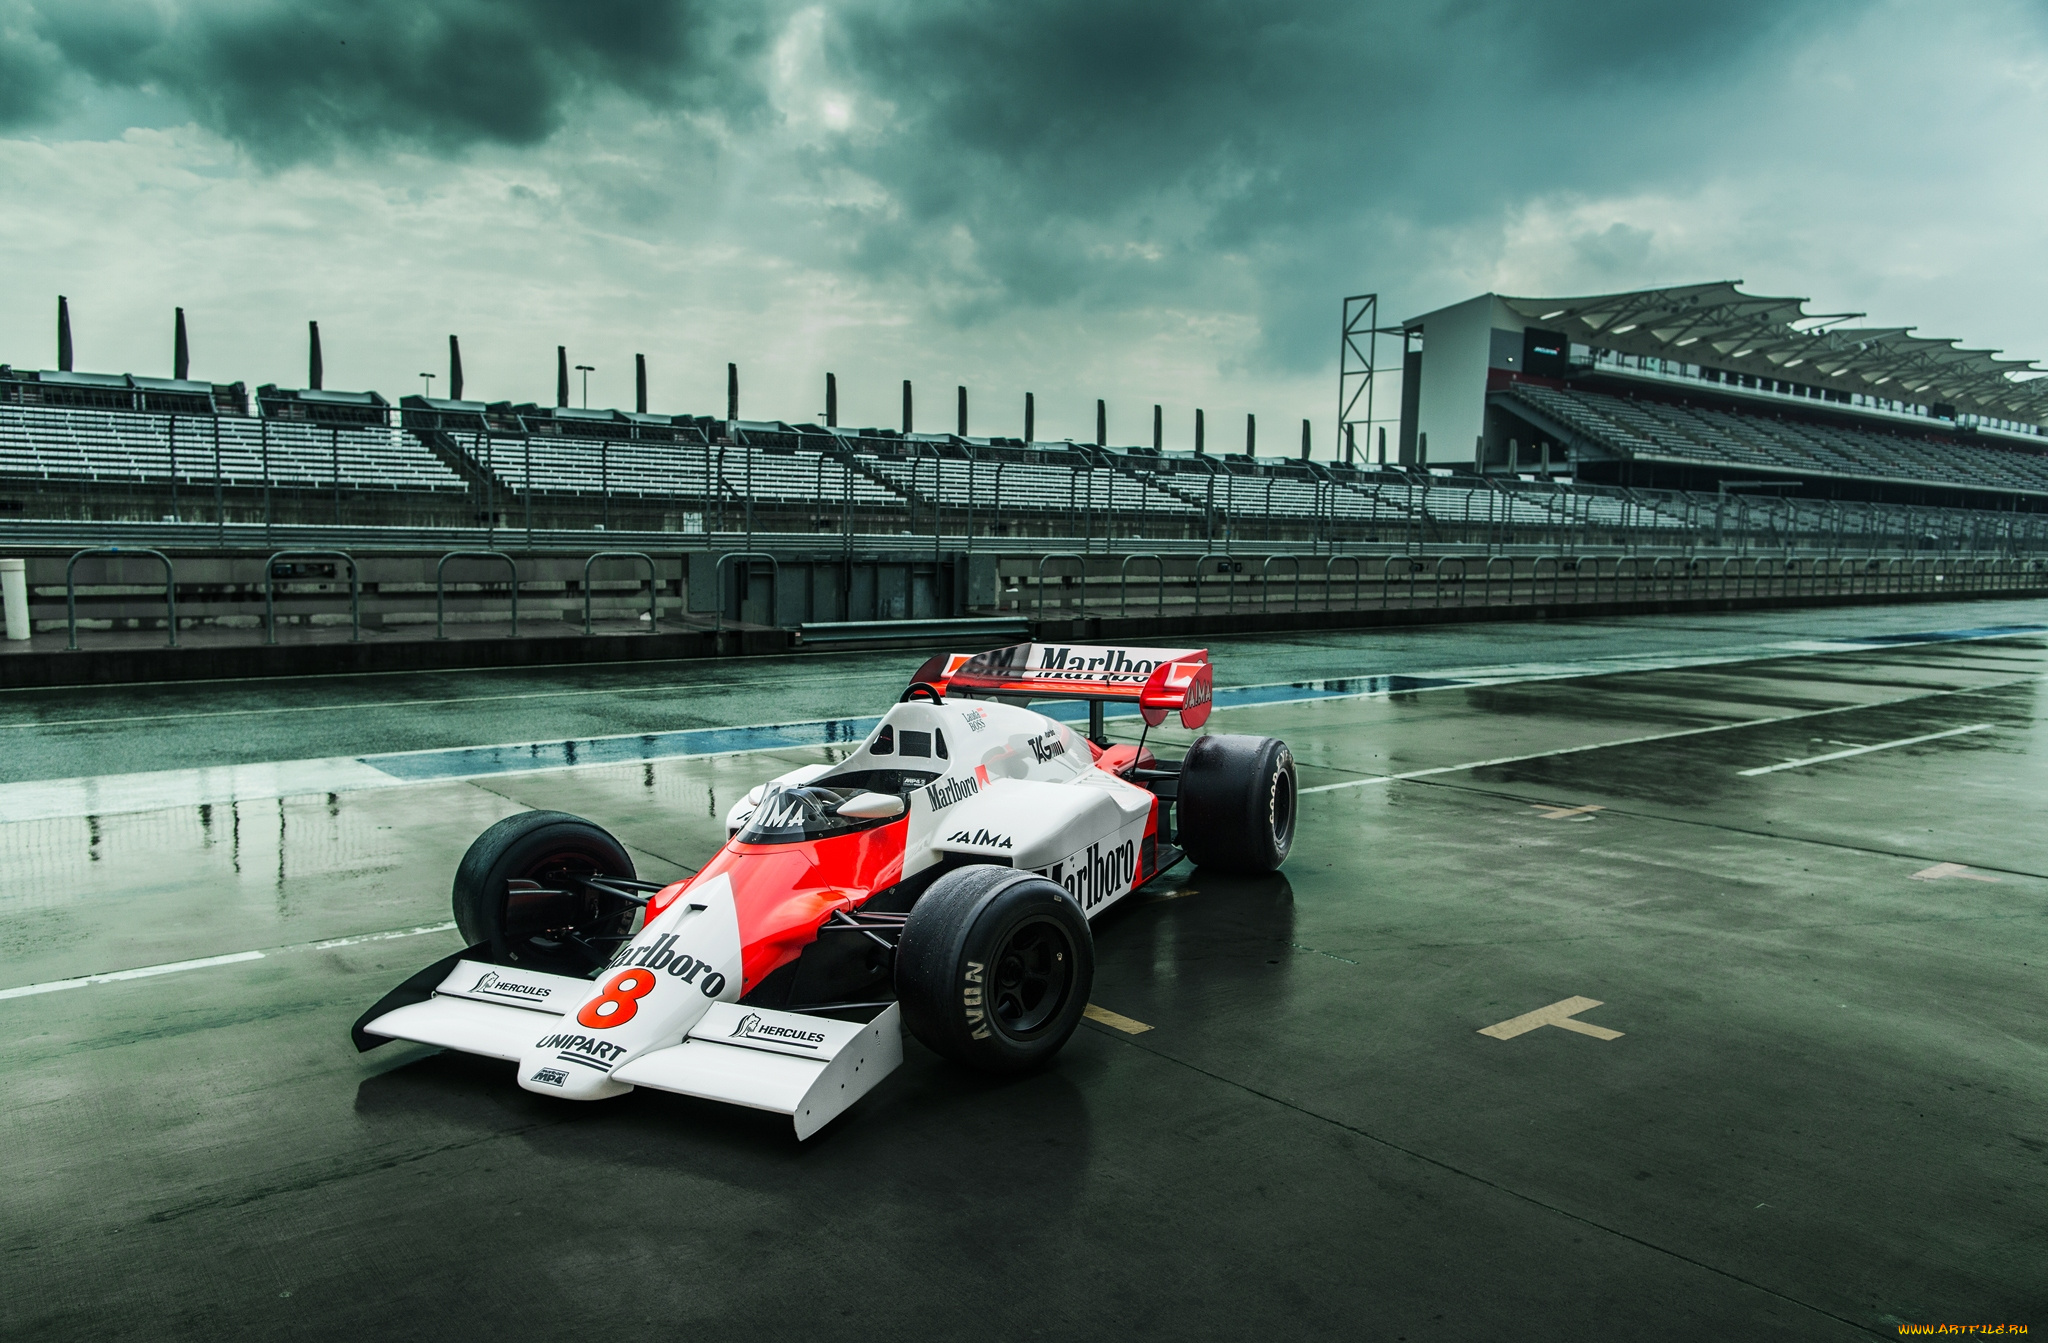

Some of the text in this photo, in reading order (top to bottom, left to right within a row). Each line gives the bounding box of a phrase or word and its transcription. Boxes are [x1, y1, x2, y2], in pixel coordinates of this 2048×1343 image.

[962, 709, 981, 723] Lauda
[969, 719, 986, 732] BOSS
[1027, 735, 1052, 765] TAG
[925, 776, 979, 812] Marlboro
[946, 828, 1013, 849] SAIMA
[1032, 839, 1134, 911] arlboro
[604, 933, 726, 998] arlboro
[494, 981, 552, 997] HERCULES
[577, 967, 657, 1029] 8
[963, 961, 992, 1041] AVON
[758, 1024, 826, 1043] HERCULES
[535, 1034, 628, 1062] UNIPART
[534, 1072, 563, 1085] MP4
